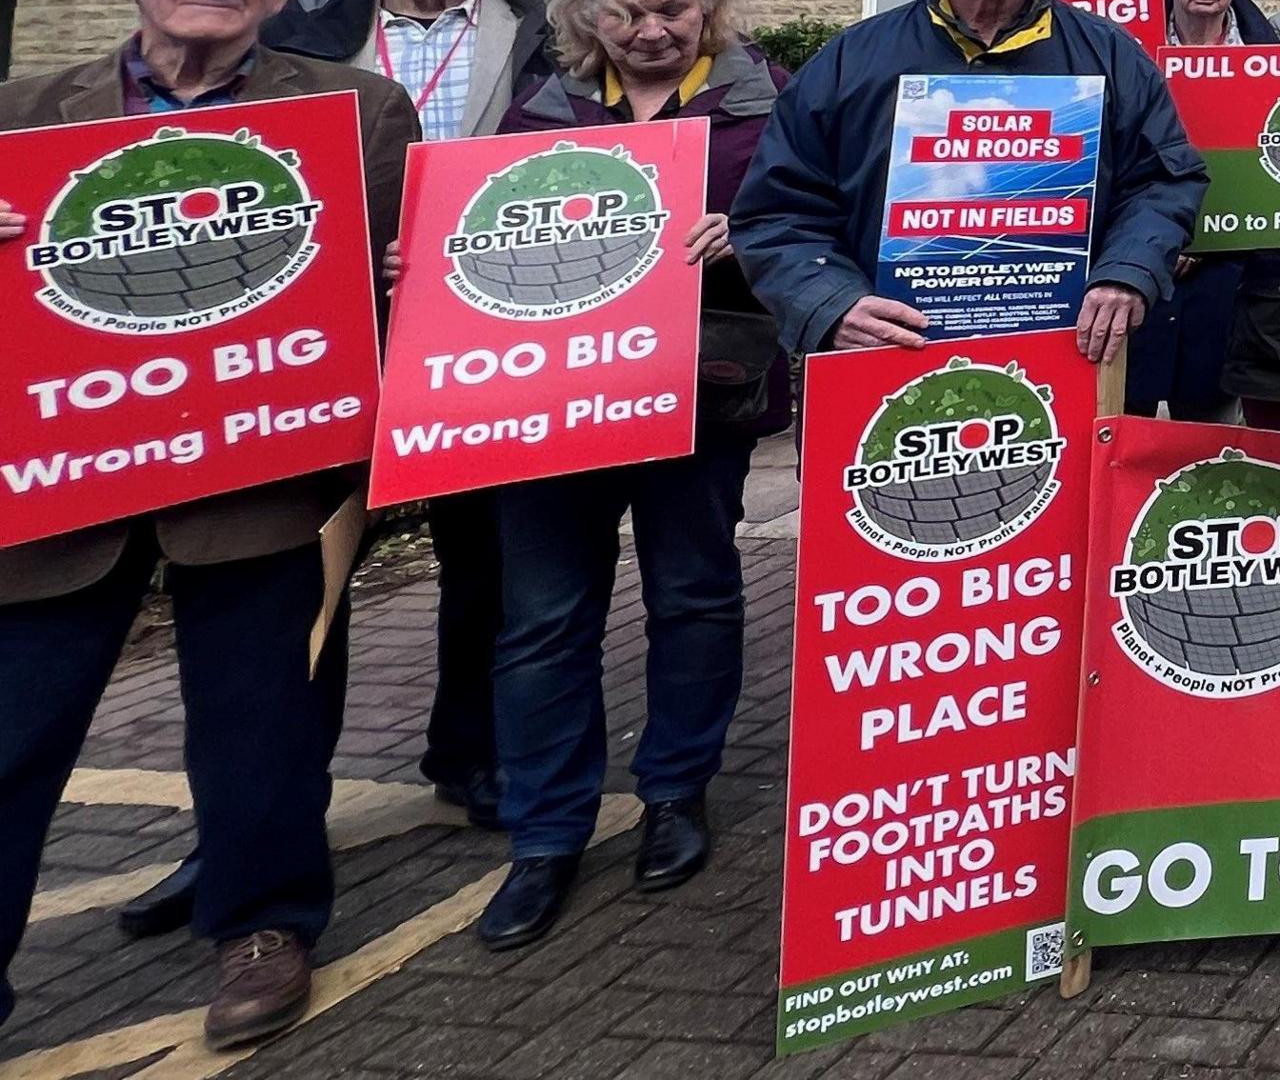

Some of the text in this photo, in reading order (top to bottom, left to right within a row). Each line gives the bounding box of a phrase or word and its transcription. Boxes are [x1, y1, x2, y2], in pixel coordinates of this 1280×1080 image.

[1166, 57, 1234, 77] PULL
[934, 139, 1060, 158] ON ROOFS
[963, 116, 1032, 132] SOLAR
[33, 204, 320, 266] BOTLEY WEST
[100, 186, 258, 232] STOP
[903, 206, 1075, 229] NOT IN FIELDS
[1204, 214, 1238, 232] NO
[1246, 213, 1266, 231] to
[895, 262, 1075, 277] NO TO BOTLEY WEST
[911, 275, 1060, 289] POWER STATION
[28, 329, 328, 420] TOO BIG
[424, 326, 658, 389] TOO BIG
[3, 396, 361, 493] Wrong Place
[391, 391, 678, 457] Wrong Place
[814, 554, 1072, 633] TOO BIG!
[1115, 560, 1254, 592] BOTLEY
[824, 616, 1061, 693] WRONG
[860, 681, 1027, 751] PLACE
[800, 748, 1076, 837] DON'T TURN
[809, 785, 1066, 872] FOOTPATHS
[885, 838, 995, 891] INTO
[1083, 843, 1210, 913] GO
[835, 865, 1037, 942] TUNNELS
[785, 951, 969, 1012] FIND OUT WHY AT:
[785, 966, 1012, 1038] stopbotleywest.com
